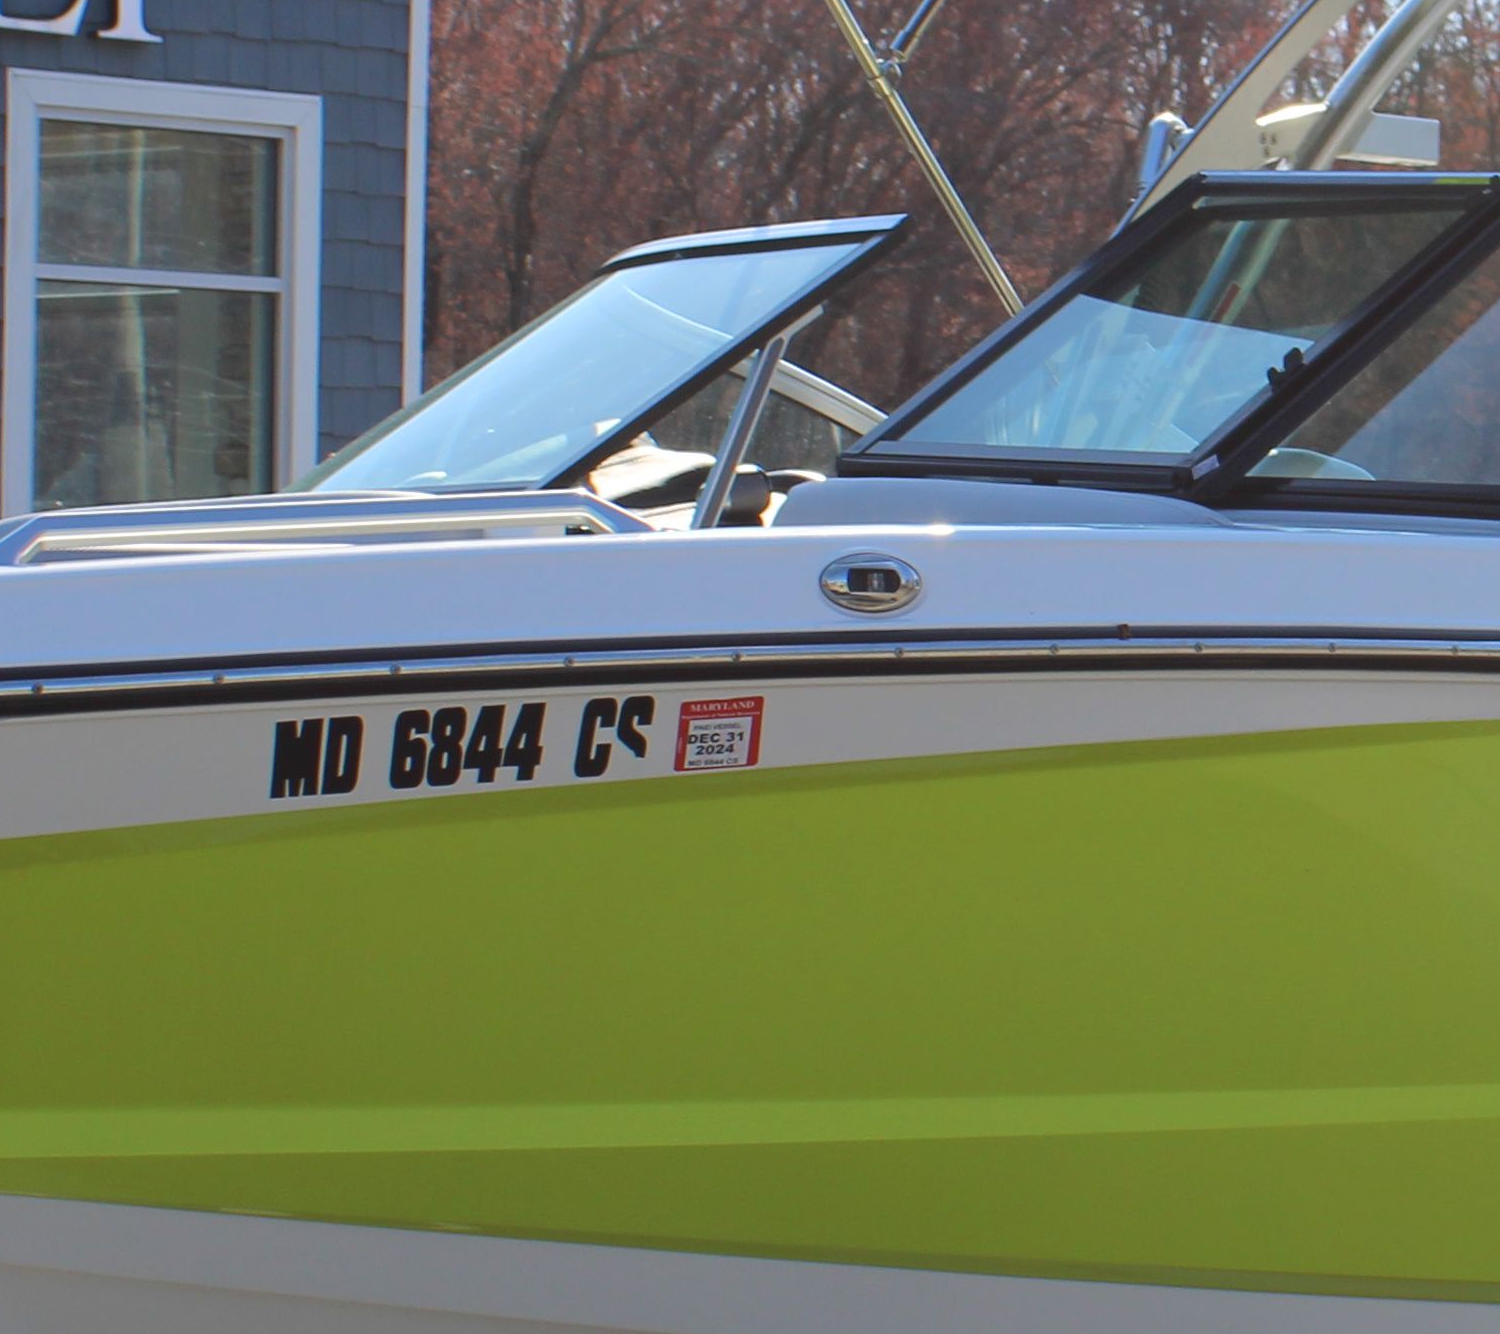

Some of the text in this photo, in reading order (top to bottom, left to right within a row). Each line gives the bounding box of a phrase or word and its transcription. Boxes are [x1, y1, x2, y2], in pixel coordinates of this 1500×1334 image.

[690, 700, 755, 712] MARYLAND
[687, 732, 745, 744] DEC 31
[269, 715, 364, 800] MD
[389, 702, 548, 790] 6844
[695, 744, 735, 756] 2024
